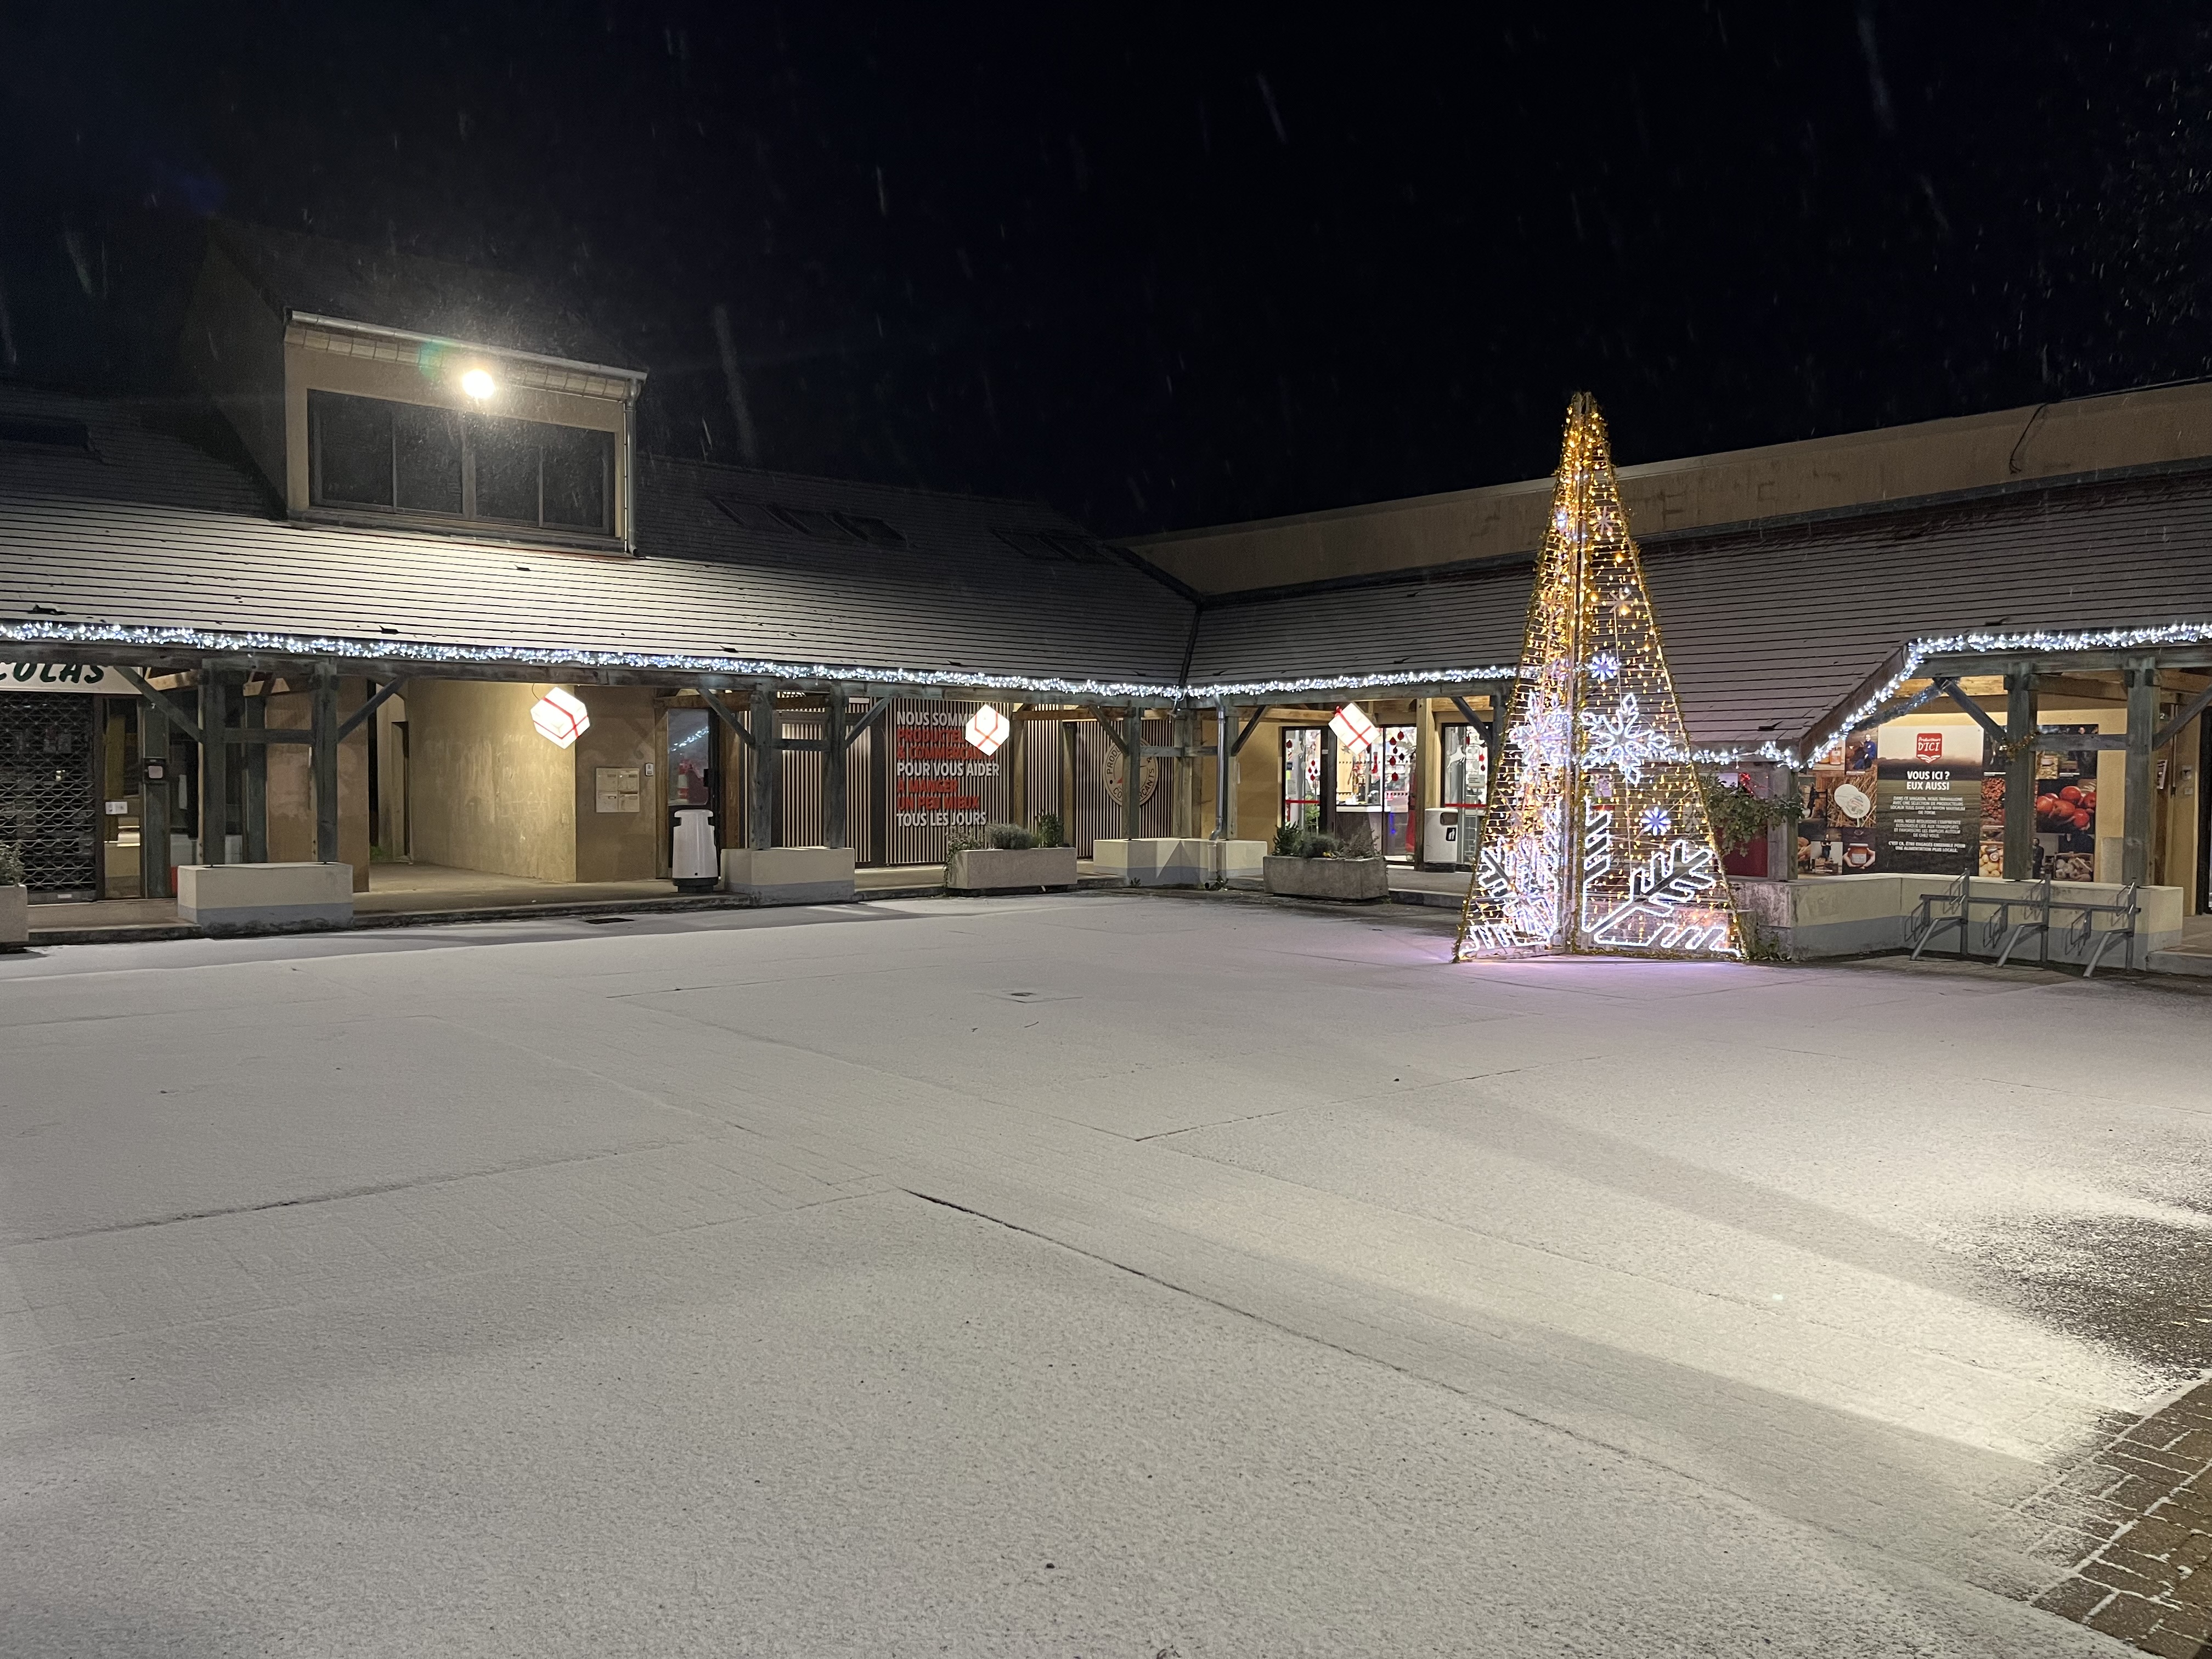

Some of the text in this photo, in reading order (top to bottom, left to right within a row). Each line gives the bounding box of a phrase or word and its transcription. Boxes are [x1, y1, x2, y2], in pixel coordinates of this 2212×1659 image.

[896, 711, 974, 726] NOUS SOMM
[897, 746, 905, 759] &
[1917, 742, 1940, 752] D'ICI
[897, 762, 1000, 777] POUR VOUS AIDER
[1906, 771, 1950, 780] VOUS ICI ?
[909, 779, 958, 793] MANGER
[1906, 781, 1950, 791] EUX AUSSI
[897, 795, 979, 810] UN PEU MIEUX
[896, 812, 987, 827] TOUS LES JOURS
